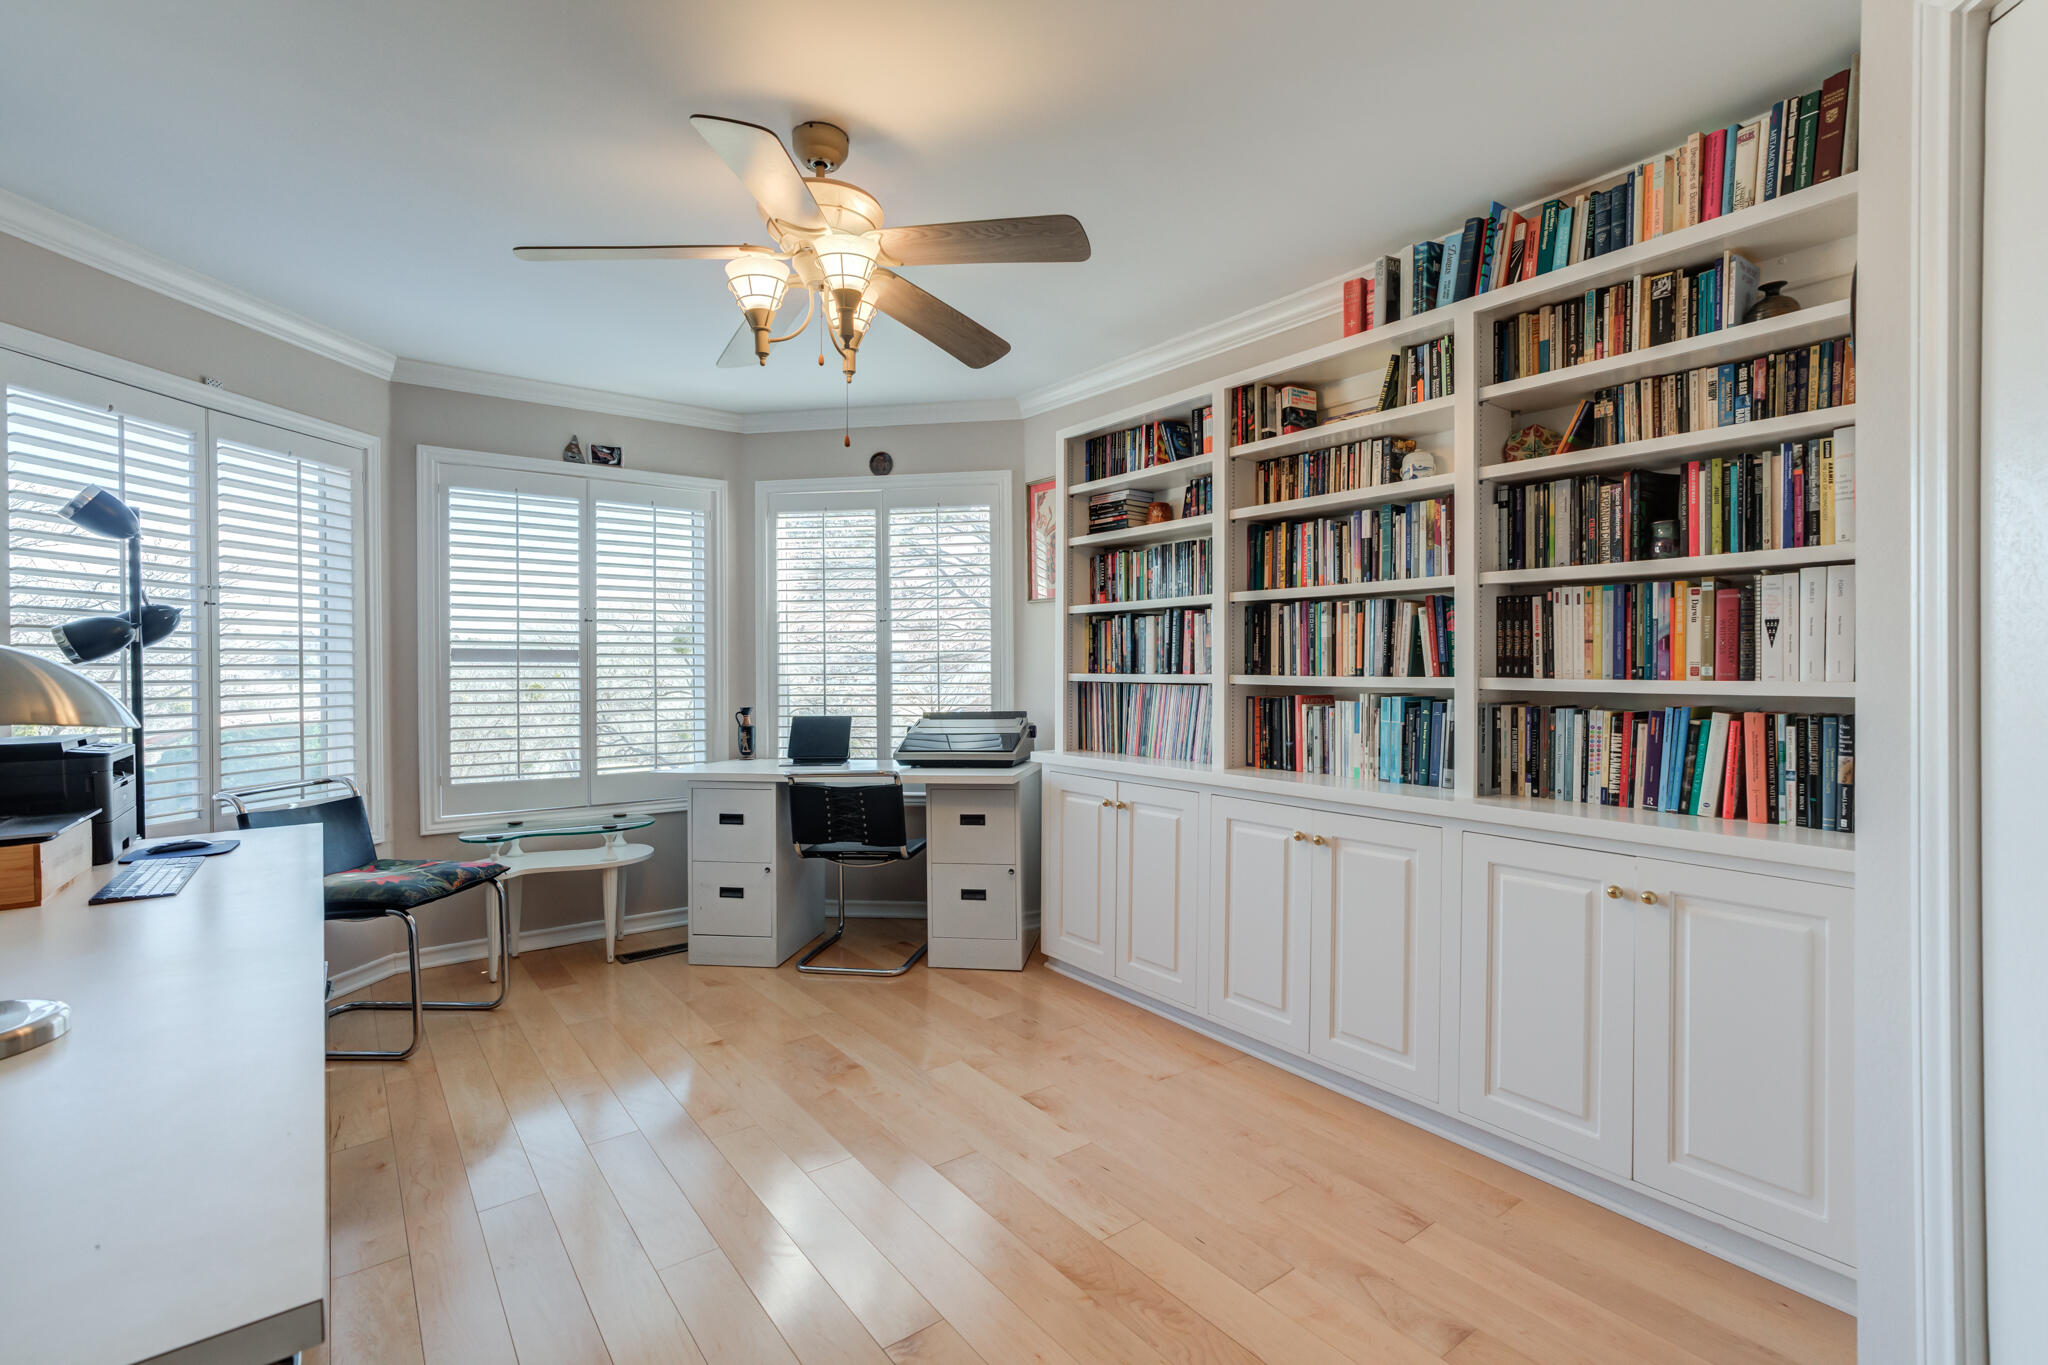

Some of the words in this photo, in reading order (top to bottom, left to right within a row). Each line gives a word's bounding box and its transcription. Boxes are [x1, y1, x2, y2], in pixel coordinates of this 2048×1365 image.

[1767, 128, 1777, 196] METAMORPHOSIS
[1708, 380, 1717, 401] ENTROPY
[1600, 491, 1610, 531] EXPANDED
[1588, 518, 1596, 540] CHAOS
[1600, 533, 1610, 562] CINEMA
[1690, 599, 1699, 623] Darwin
[1704, 615, 1712, 640] DARWIN
[1727, 609, 1736, 663] EVOLUTIONARY
[1611, 733, 1622, 752] FILM
[1609, 753, 1622, 794] LANGUAGE
